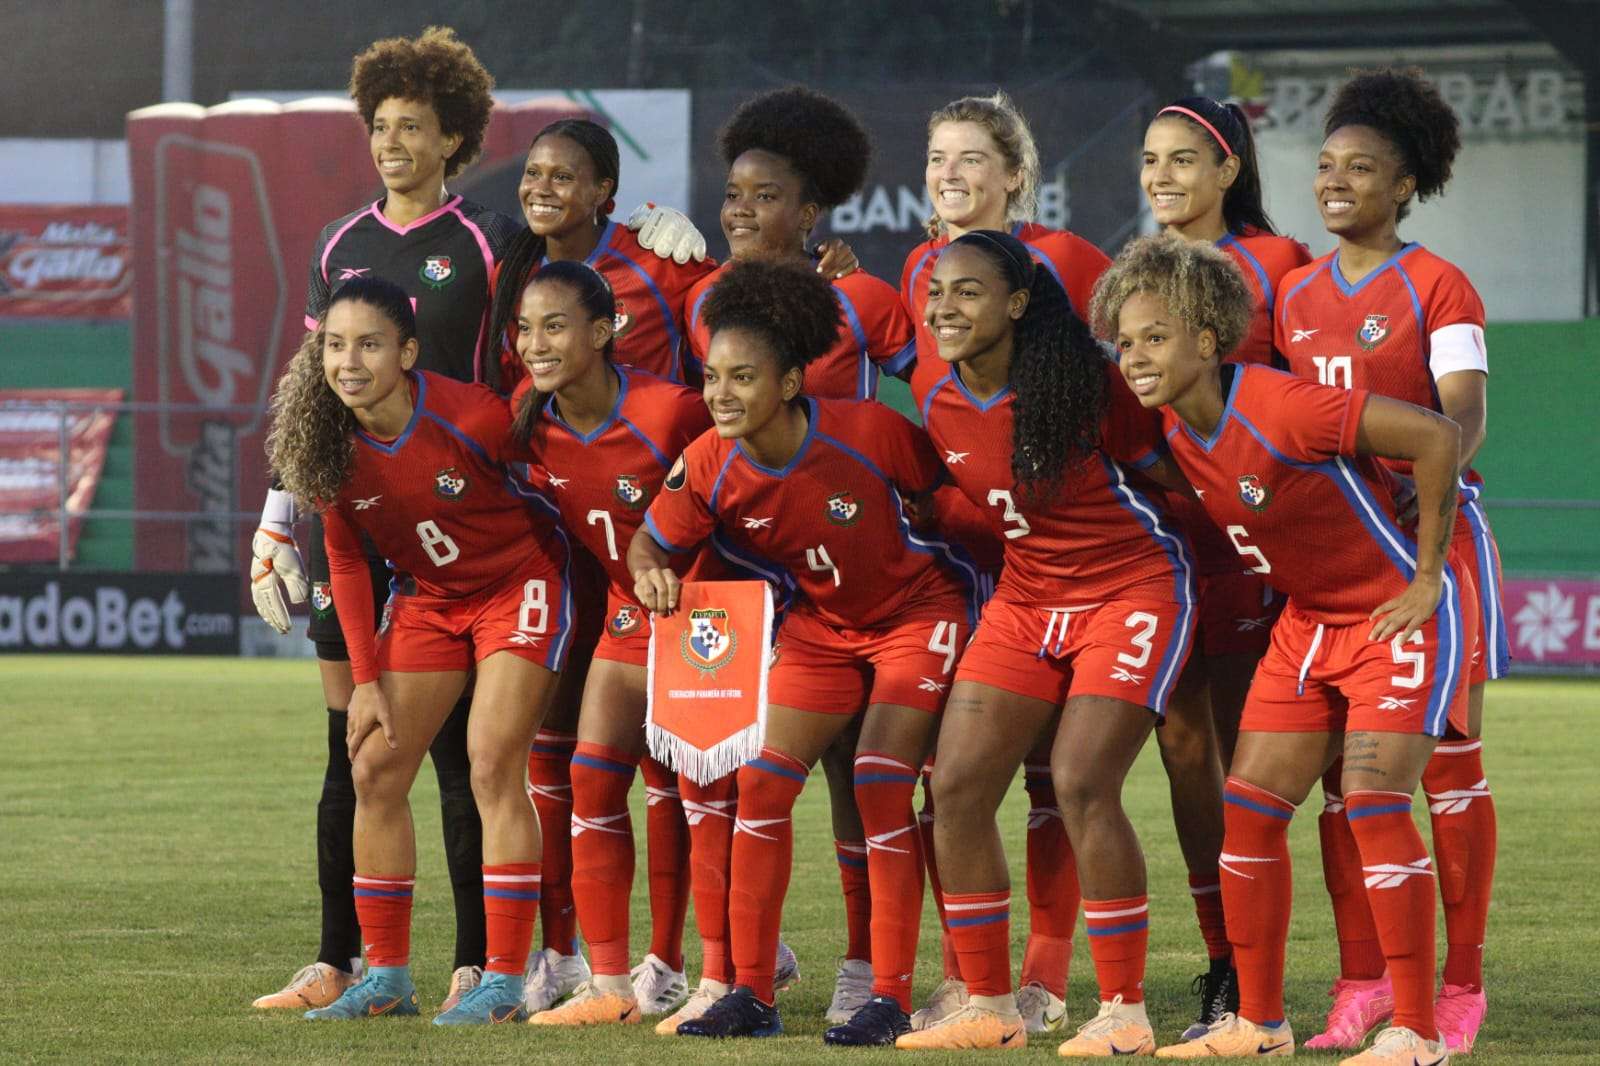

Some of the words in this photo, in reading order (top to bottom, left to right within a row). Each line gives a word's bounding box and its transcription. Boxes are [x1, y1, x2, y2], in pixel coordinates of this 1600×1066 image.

[1312, 356, 1353, 390] 10
[587, 509, 618, 560] 7
[987, 489, 1031, 539] 3
[416, 519, 460, 567] 8
[806, 544, 840, 587] 4
[1226, 525, 1271, 576] 5
[518, 579, 549, 634] 8
[928, 620, 957, 675] 4
[1117, 611, 1158, 669] 3
[1390, 629, 1425, 689] 5
